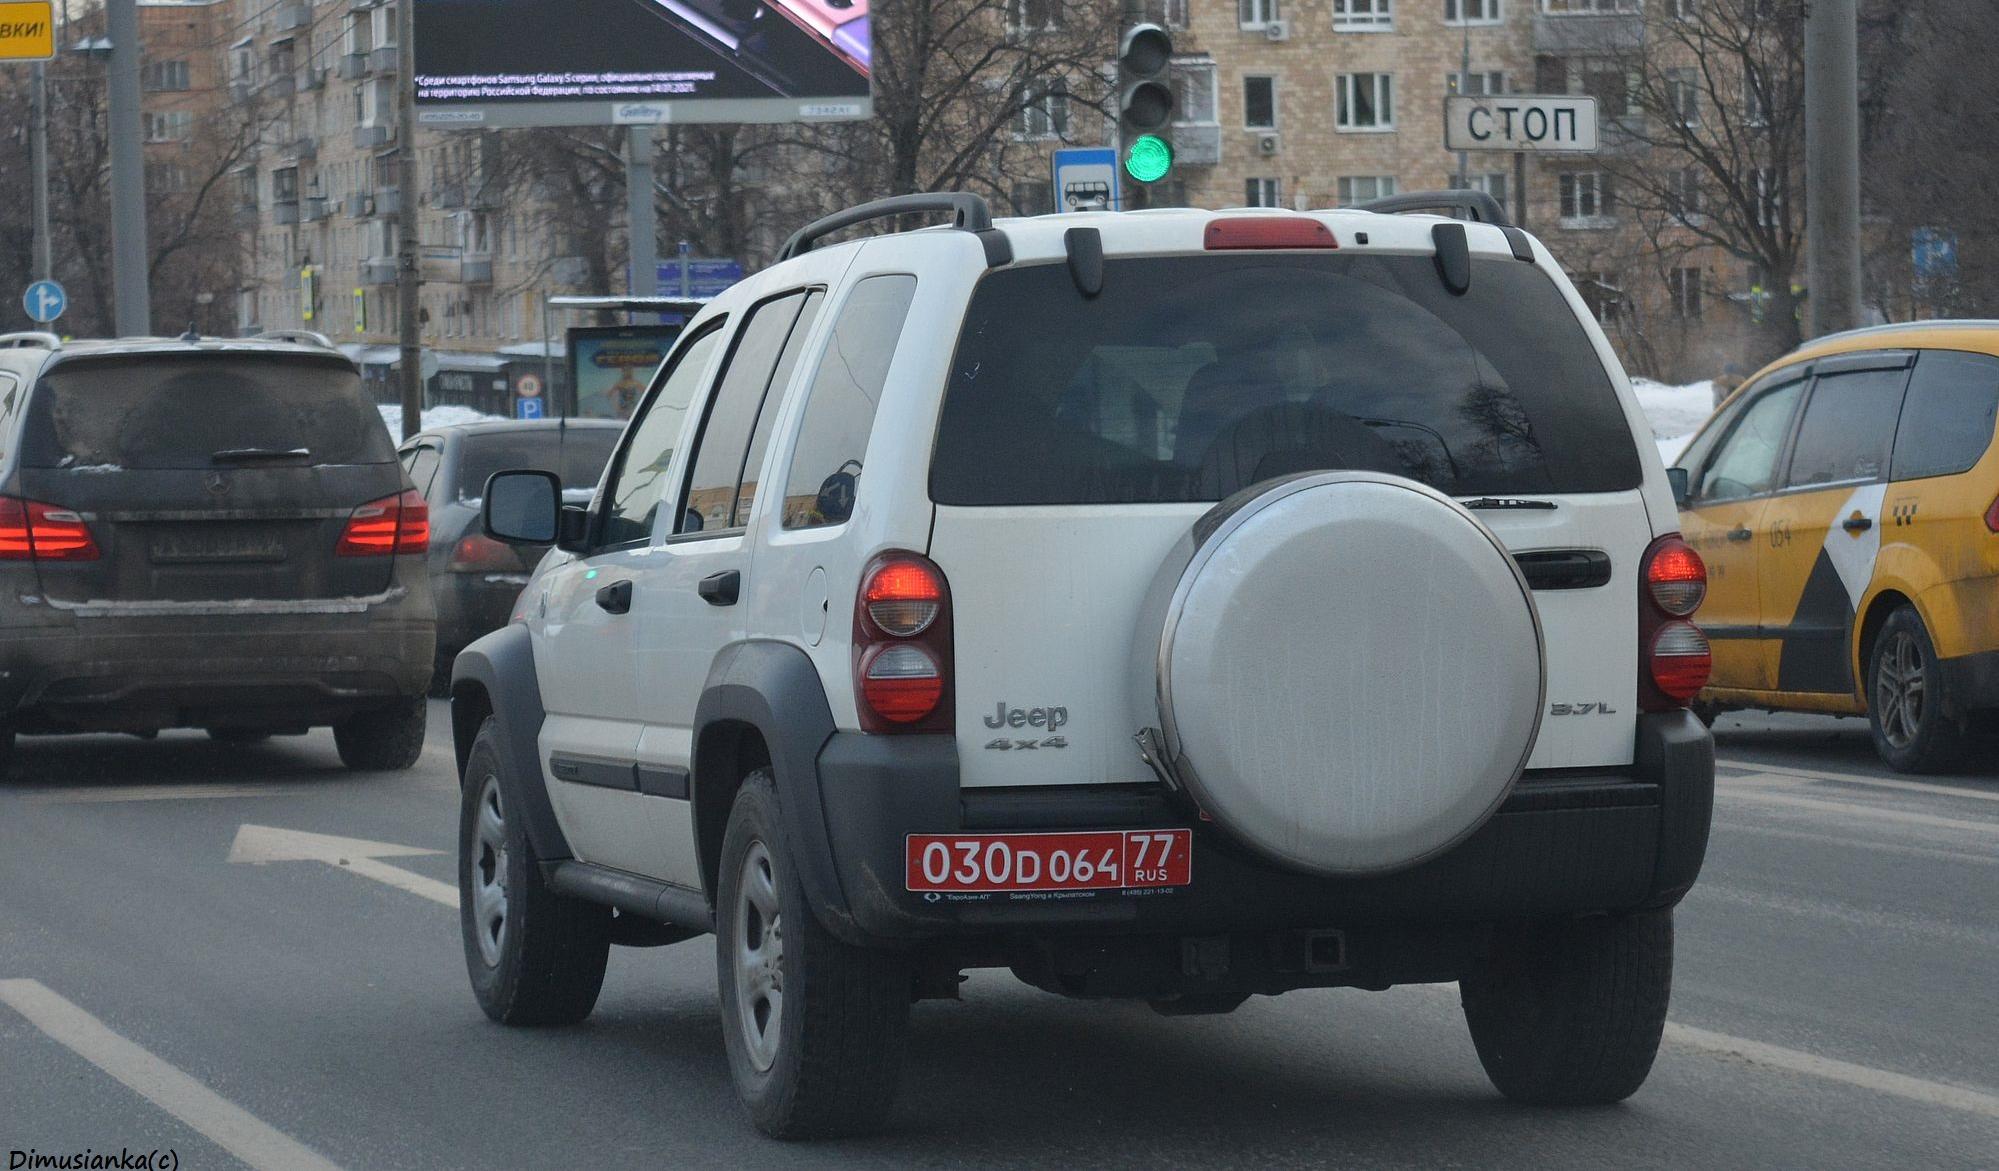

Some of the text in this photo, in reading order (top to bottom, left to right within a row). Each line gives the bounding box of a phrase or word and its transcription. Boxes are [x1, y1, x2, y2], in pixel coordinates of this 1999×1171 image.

[499, 73, 536, 86] Samsung
[537, 73, 564, 84] Galaxy
[481, 85, 531, 97] Российской
[1468, 106, 1576, 141] СТОП
[523, 400, 538, 419] P
[983, 701, 1068, 732] Jeep
[984, 735, 1069, 751] 4x4
[1130, 833, 1175, 869] 77
[1134, 868, 1169, 882] RUS
